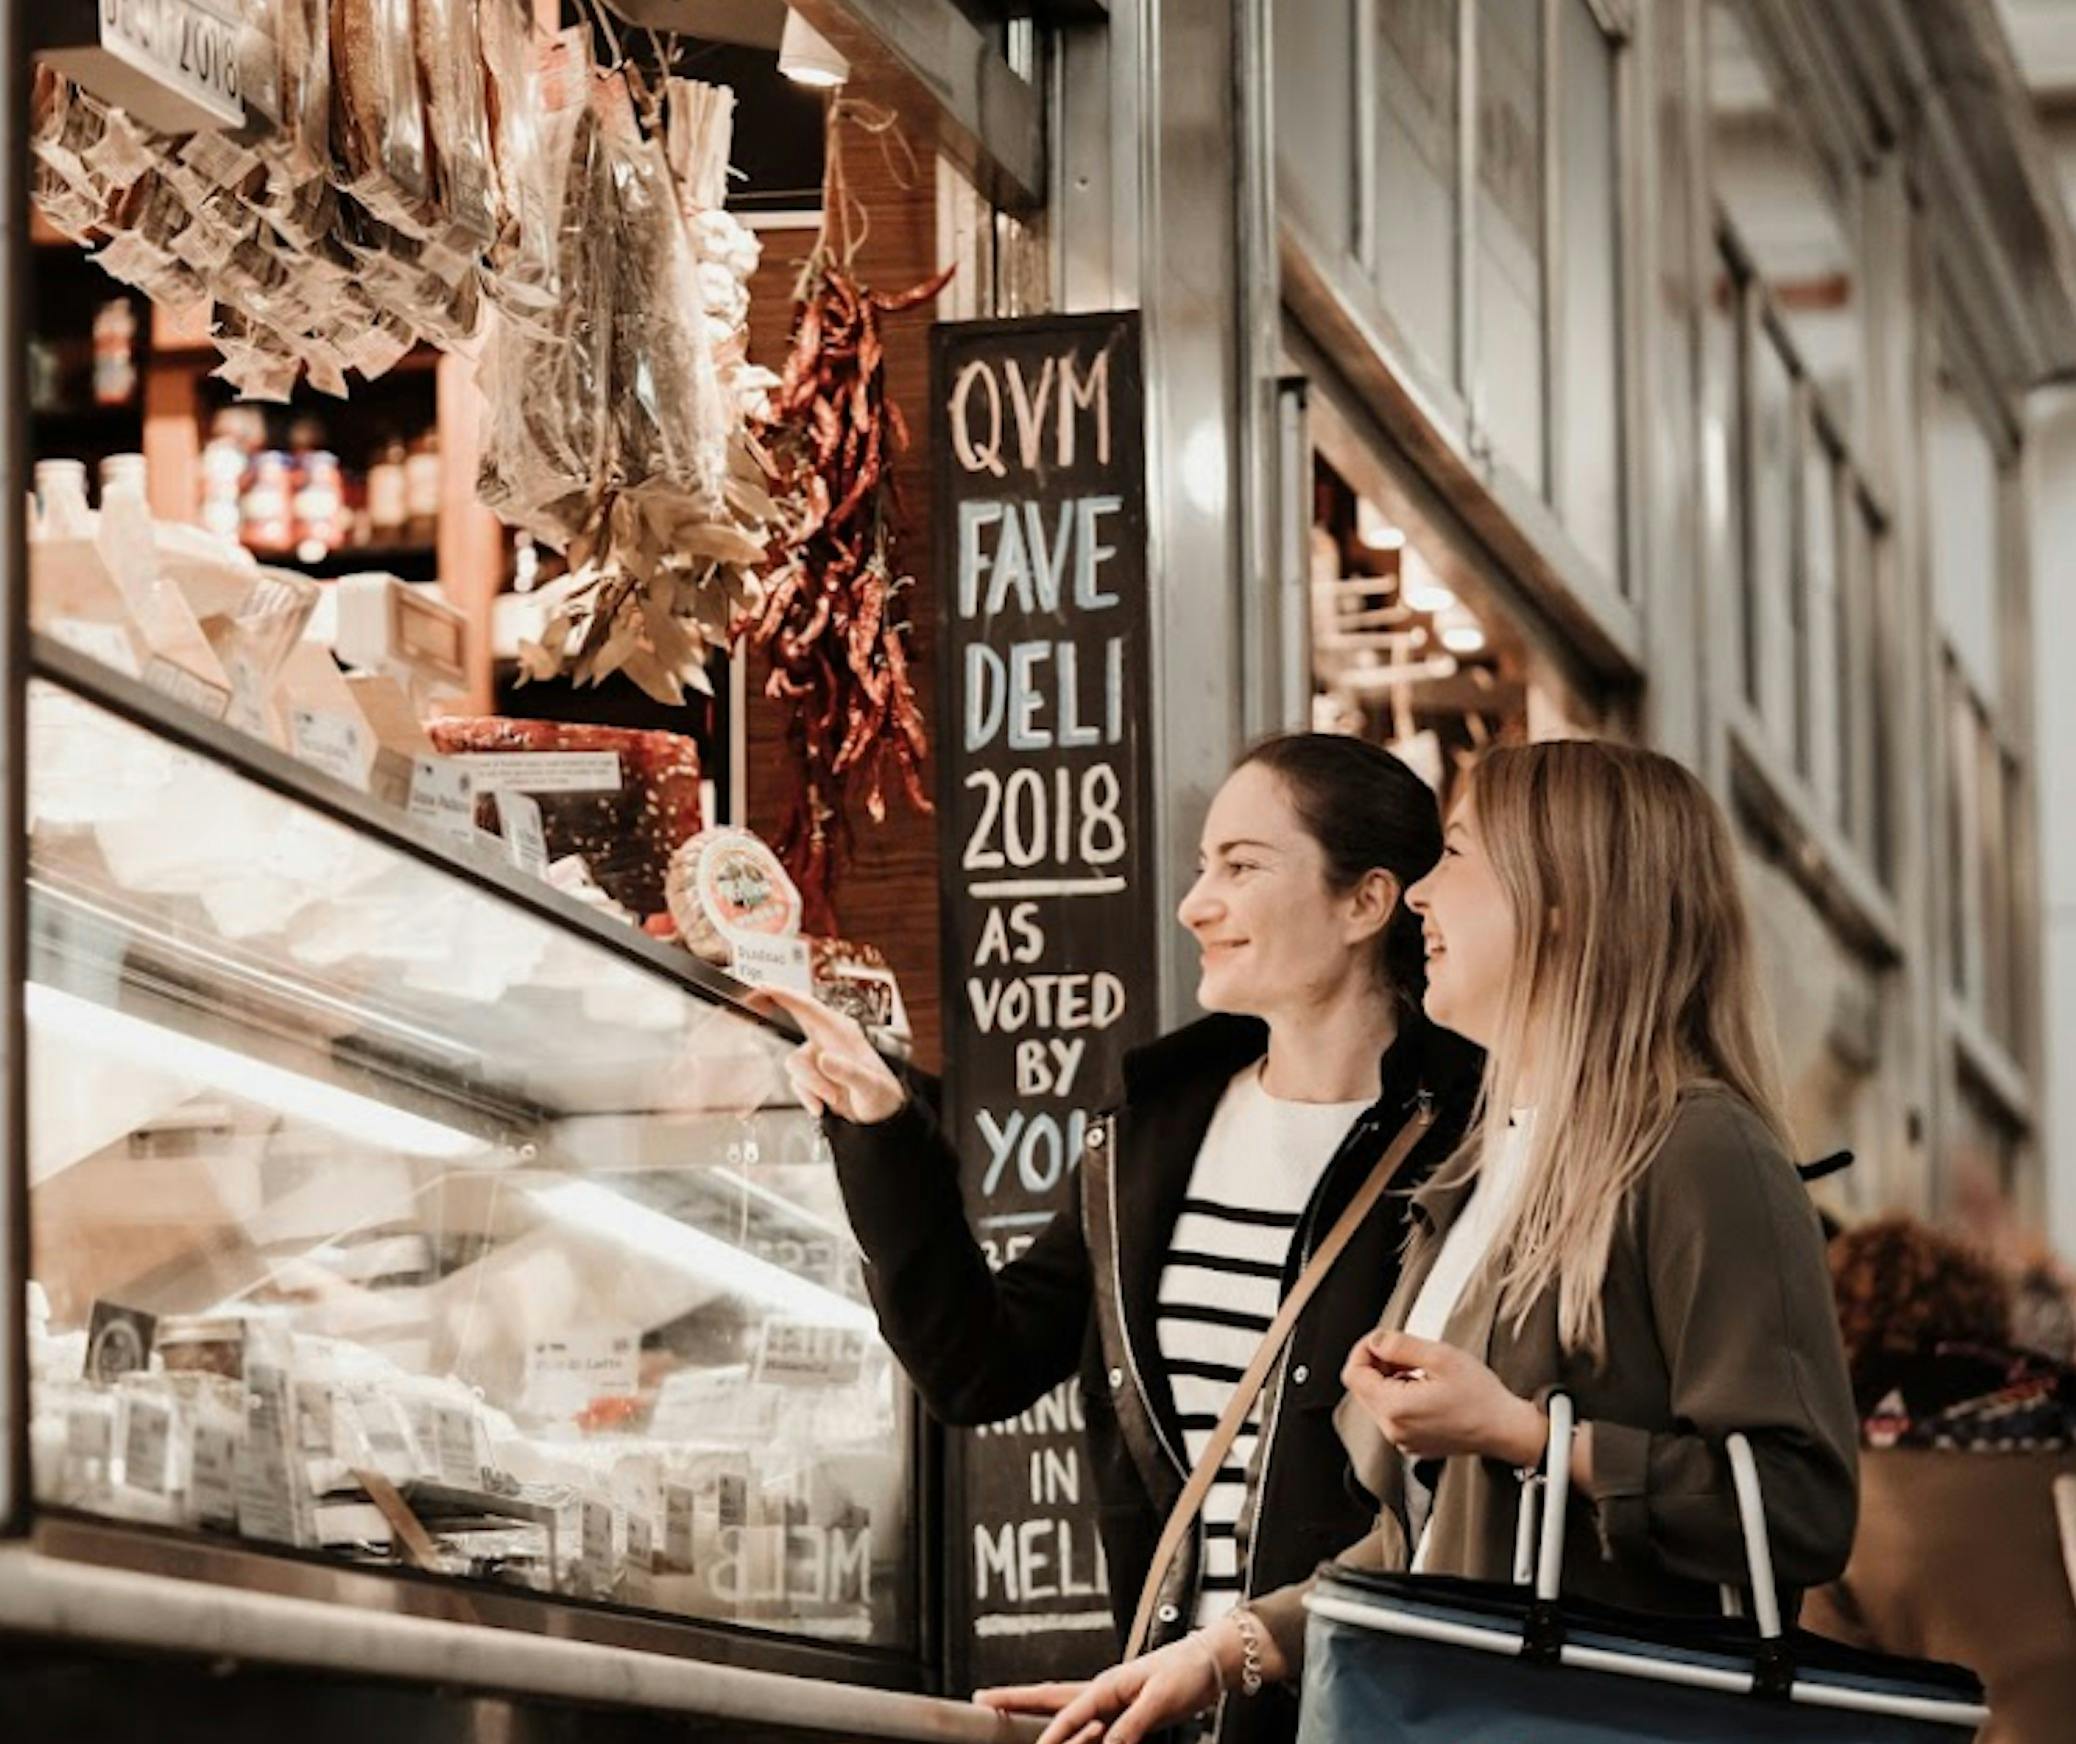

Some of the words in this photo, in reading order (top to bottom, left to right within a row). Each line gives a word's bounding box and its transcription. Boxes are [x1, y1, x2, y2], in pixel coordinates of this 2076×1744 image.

[947, 350, 1111, 480] QVM
[957, 496, 1124, 619] FAVE
[964, 636, 1123, 753] DELI
[963, 762, 1127, 871] 2018
[974, 901, 1045, 967] AS
[966, 971, 1126, 1033] VOTED
[1015, 1038, 1085, 1098] BY
[1029, 1446, 1080, 1504] IN
